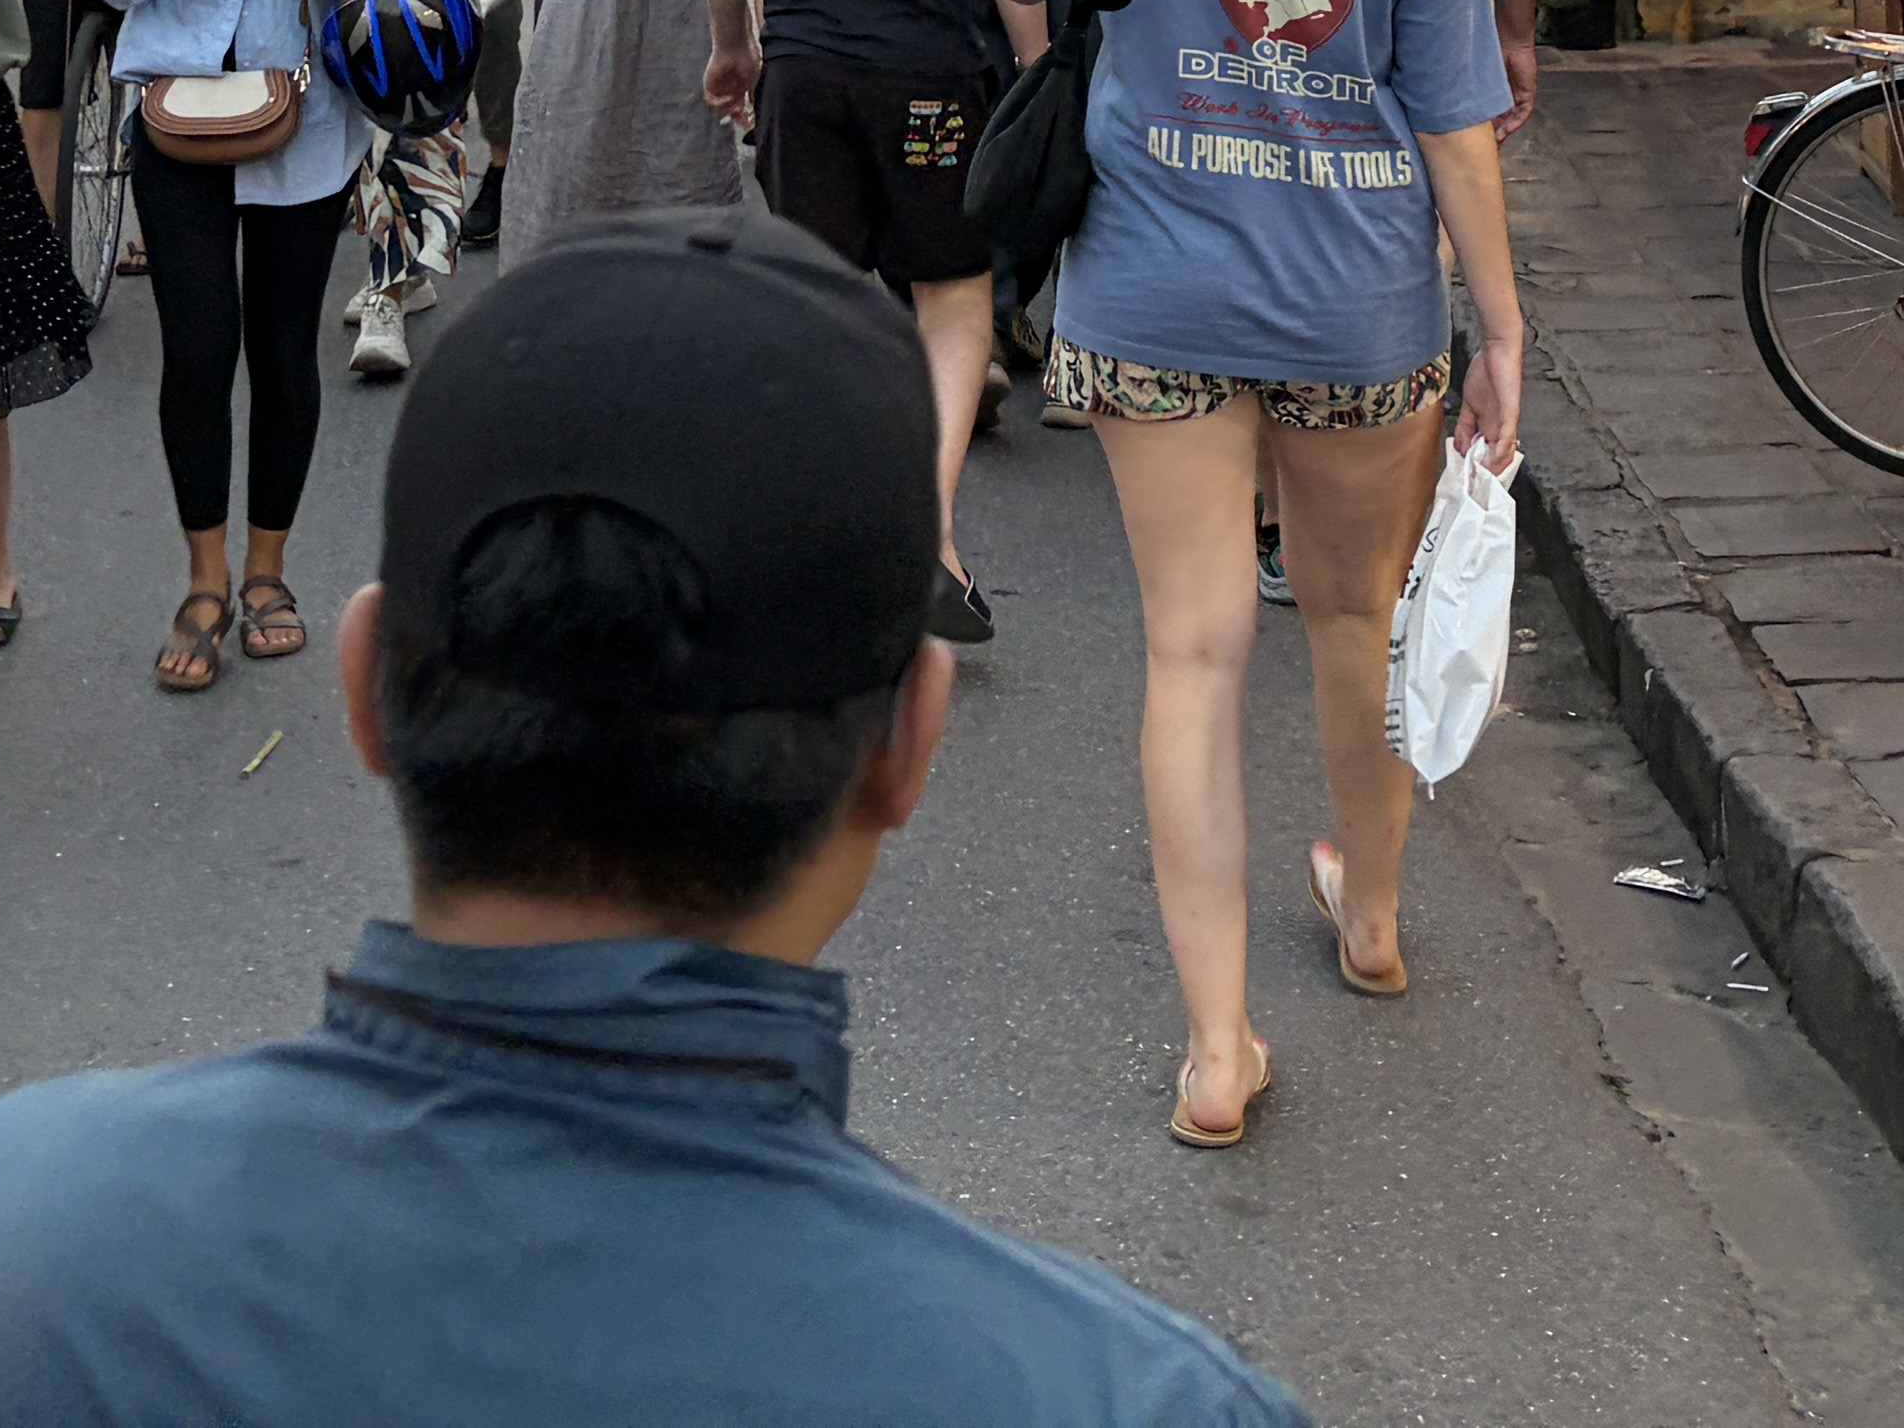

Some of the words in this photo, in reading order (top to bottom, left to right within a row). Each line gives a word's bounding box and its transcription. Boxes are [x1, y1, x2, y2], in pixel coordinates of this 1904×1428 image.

[1179, 48, 1376, 105] DETROIT
[1252, 37, 1307, 66] OF
[1148, 126, 1185, 169] ALL
[1191, 133, 1293, 182] PURPOSE
[1299, 148, 1341, 189] LIFE
[1340, 149, 1413, 189] TOOLS
